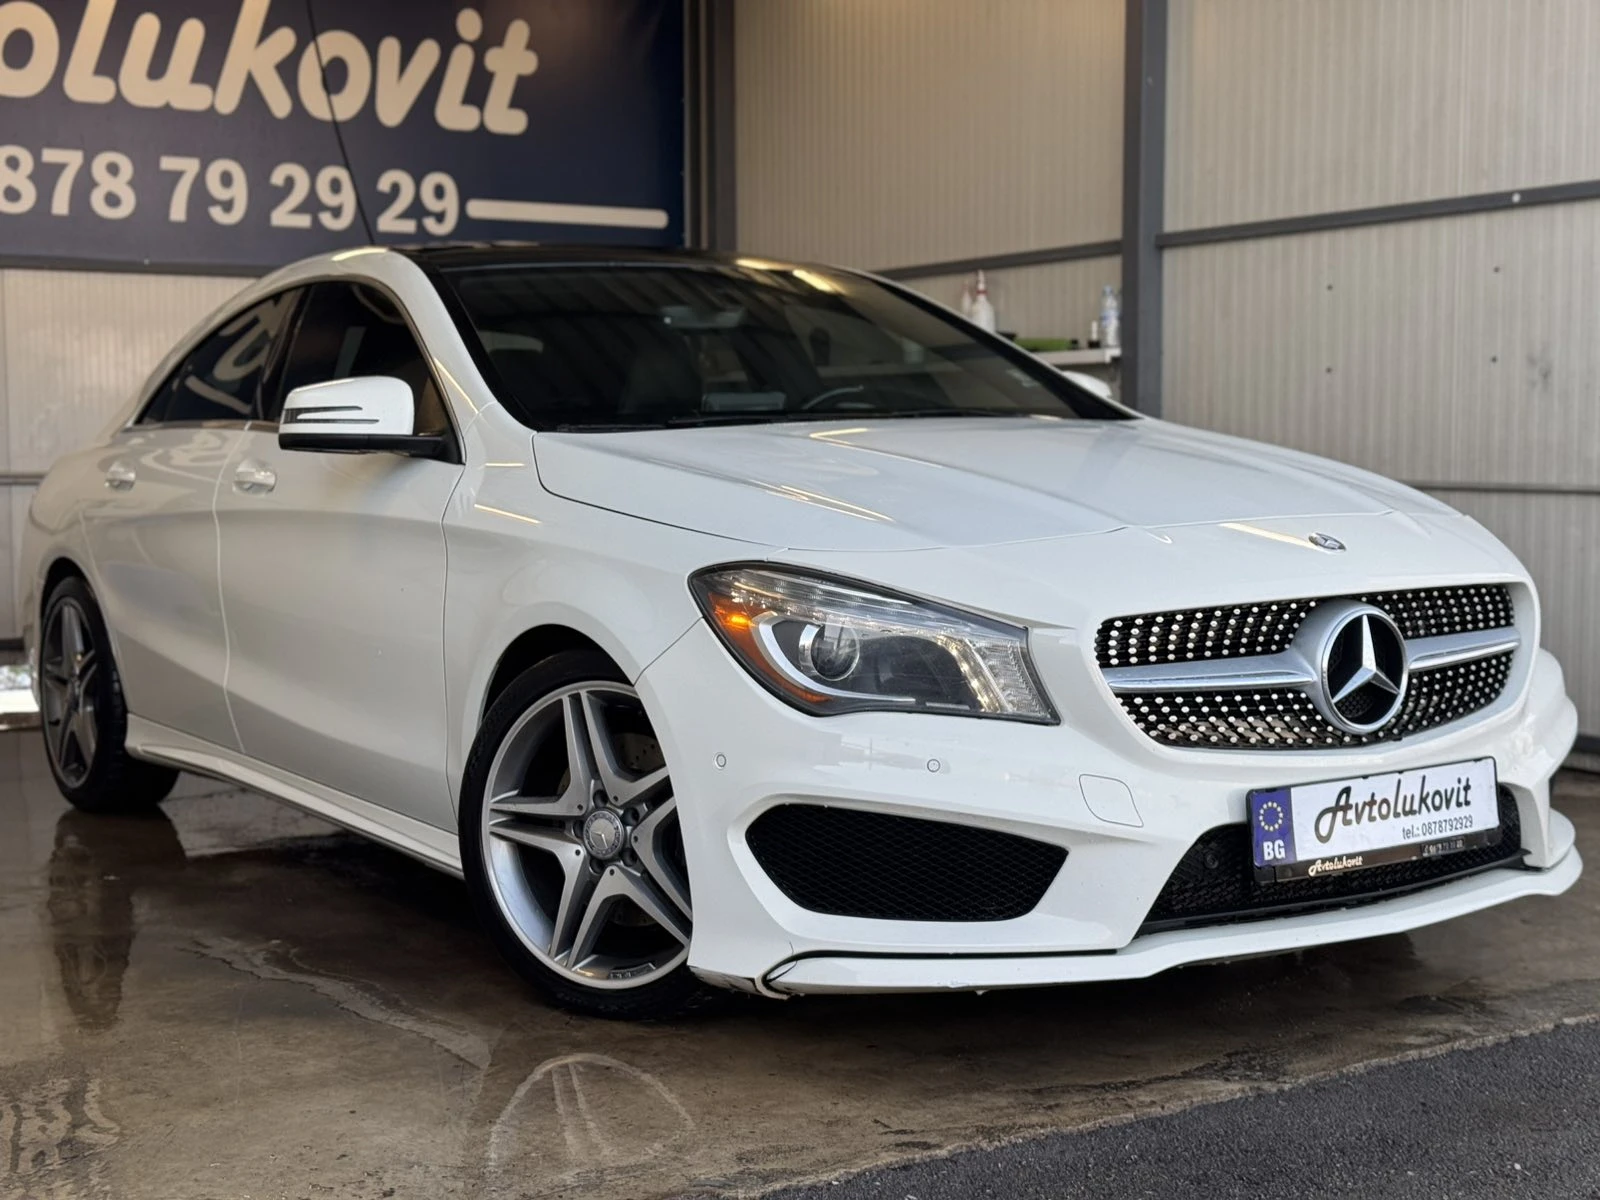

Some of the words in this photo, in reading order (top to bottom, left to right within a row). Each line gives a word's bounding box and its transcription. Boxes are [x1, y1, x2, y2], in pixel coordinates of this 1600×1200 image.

[159, 156, 248, 225] 79
[270, 163, 356, 231] 29
[376, 169, 459, 236] 29
[1314, 775, 1472, 843] Avtolukovit
[1421, 814, 1473, 837] 0878792929
[1263, 840, 1286, 860] BG
[1308, 856, 1363, 877] Avtolukovit
